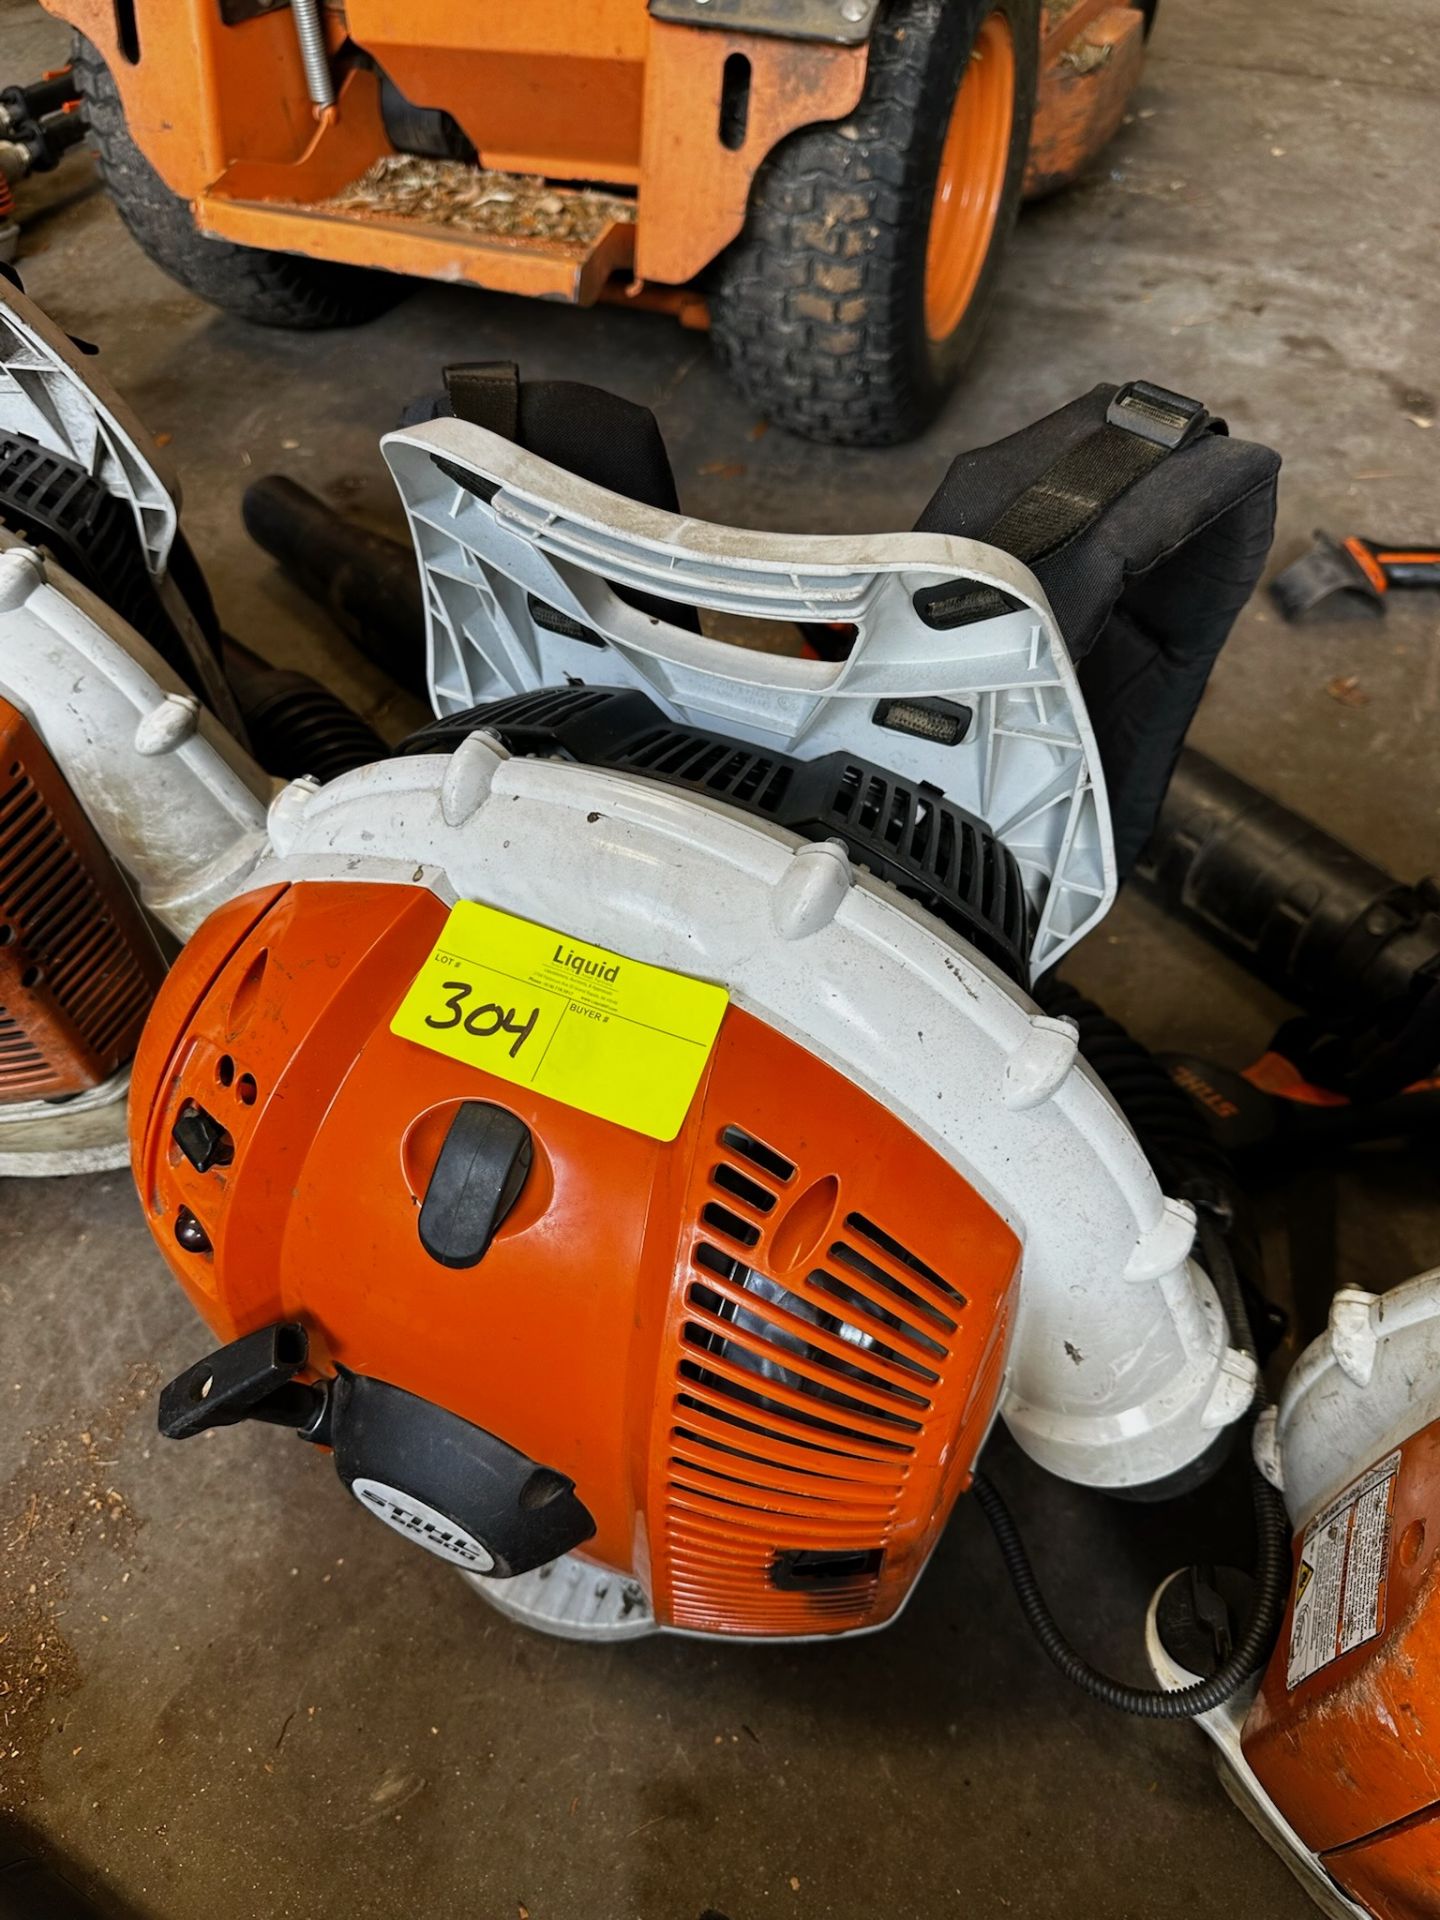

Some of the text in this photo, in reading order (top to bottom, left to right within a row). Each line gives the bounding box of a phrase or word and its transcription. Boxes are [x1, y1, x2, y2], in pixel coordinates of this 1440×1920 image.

[434, 954, 462, 969] LOT #
[553, 945, 620, 983] Liquid
[424, 981, 540, 1059] 304
[570, 1003, 602, 1021] BUYER
[602, 1016, 610, 1024] #
[361, 1489, 480, 1557] STIHL
